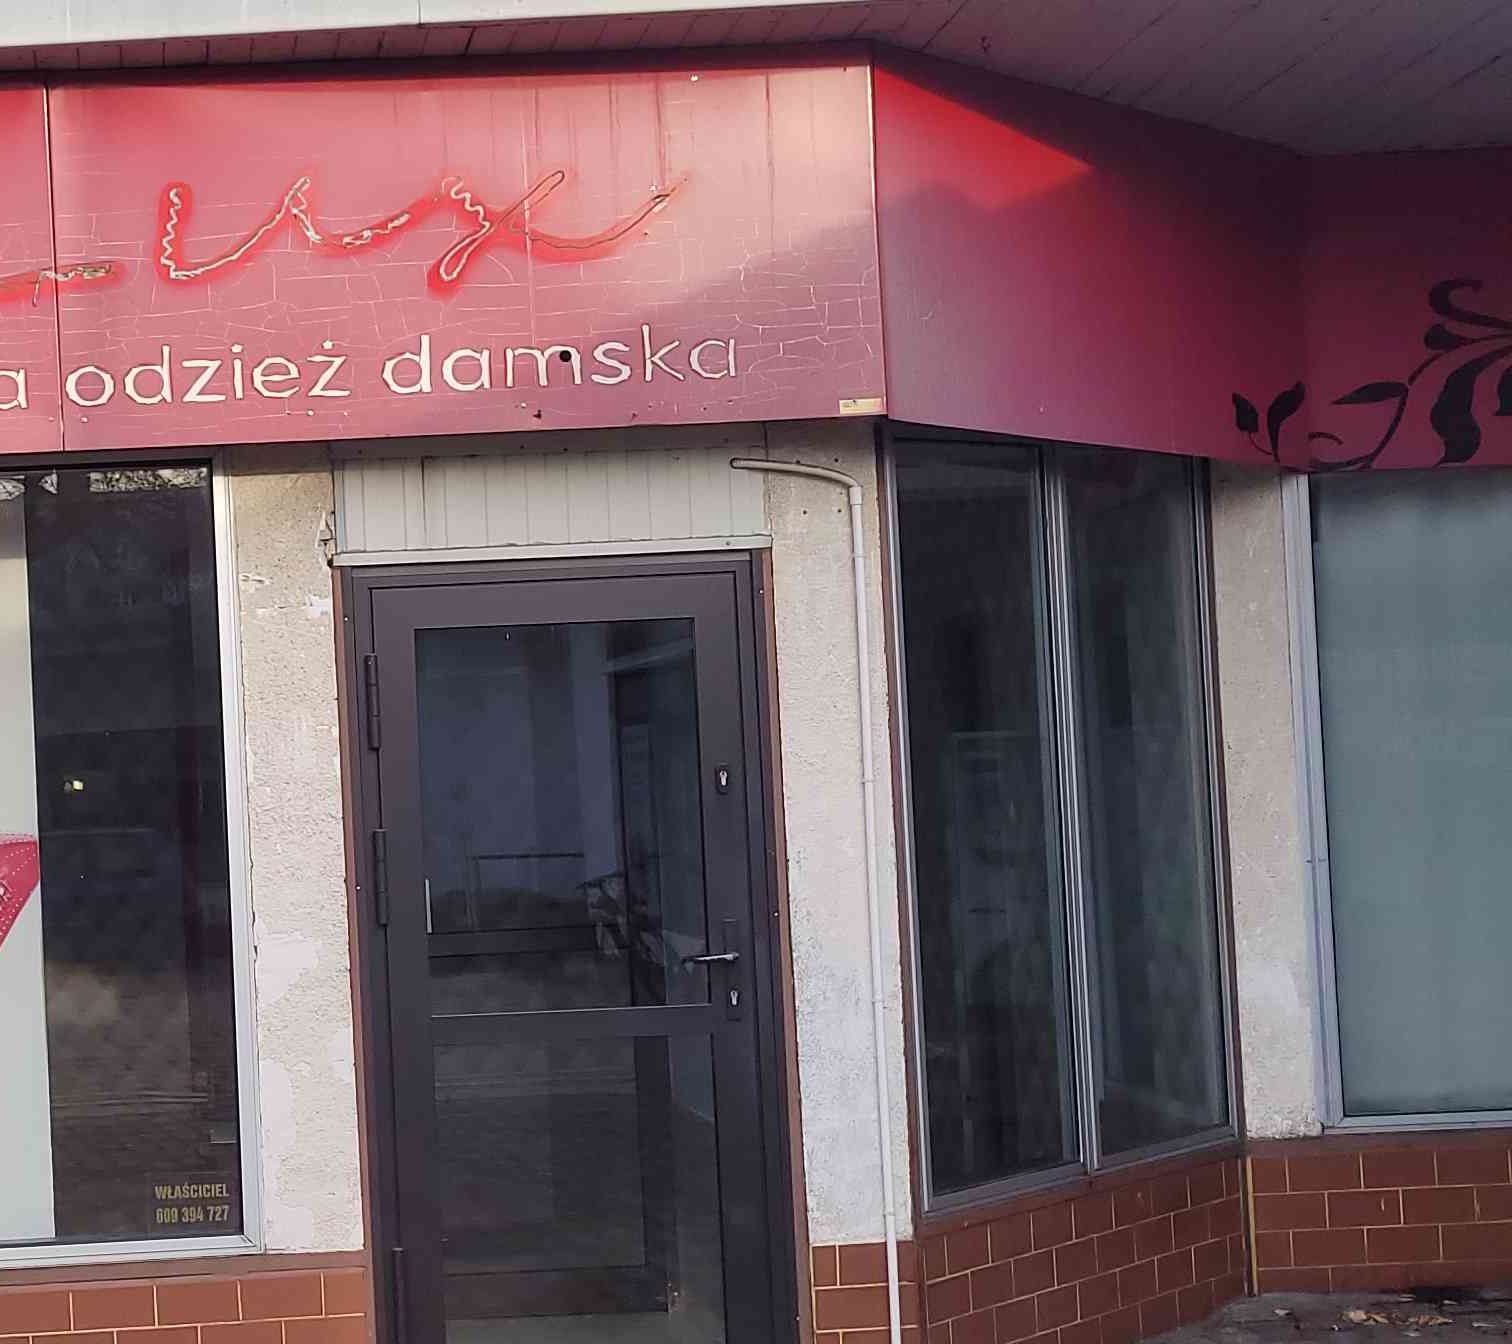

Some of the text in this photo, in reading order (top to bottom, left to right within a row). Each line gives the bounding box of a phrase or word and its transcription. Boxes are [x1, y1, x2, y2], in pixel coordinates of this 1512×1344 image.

[65, 341, 350, 407] odzież
[383, 324, 737, 394] damska
[154, 1182, 229, 1199] WŁAŚCICIEL
[207, 1205, 229, 1221] 727
